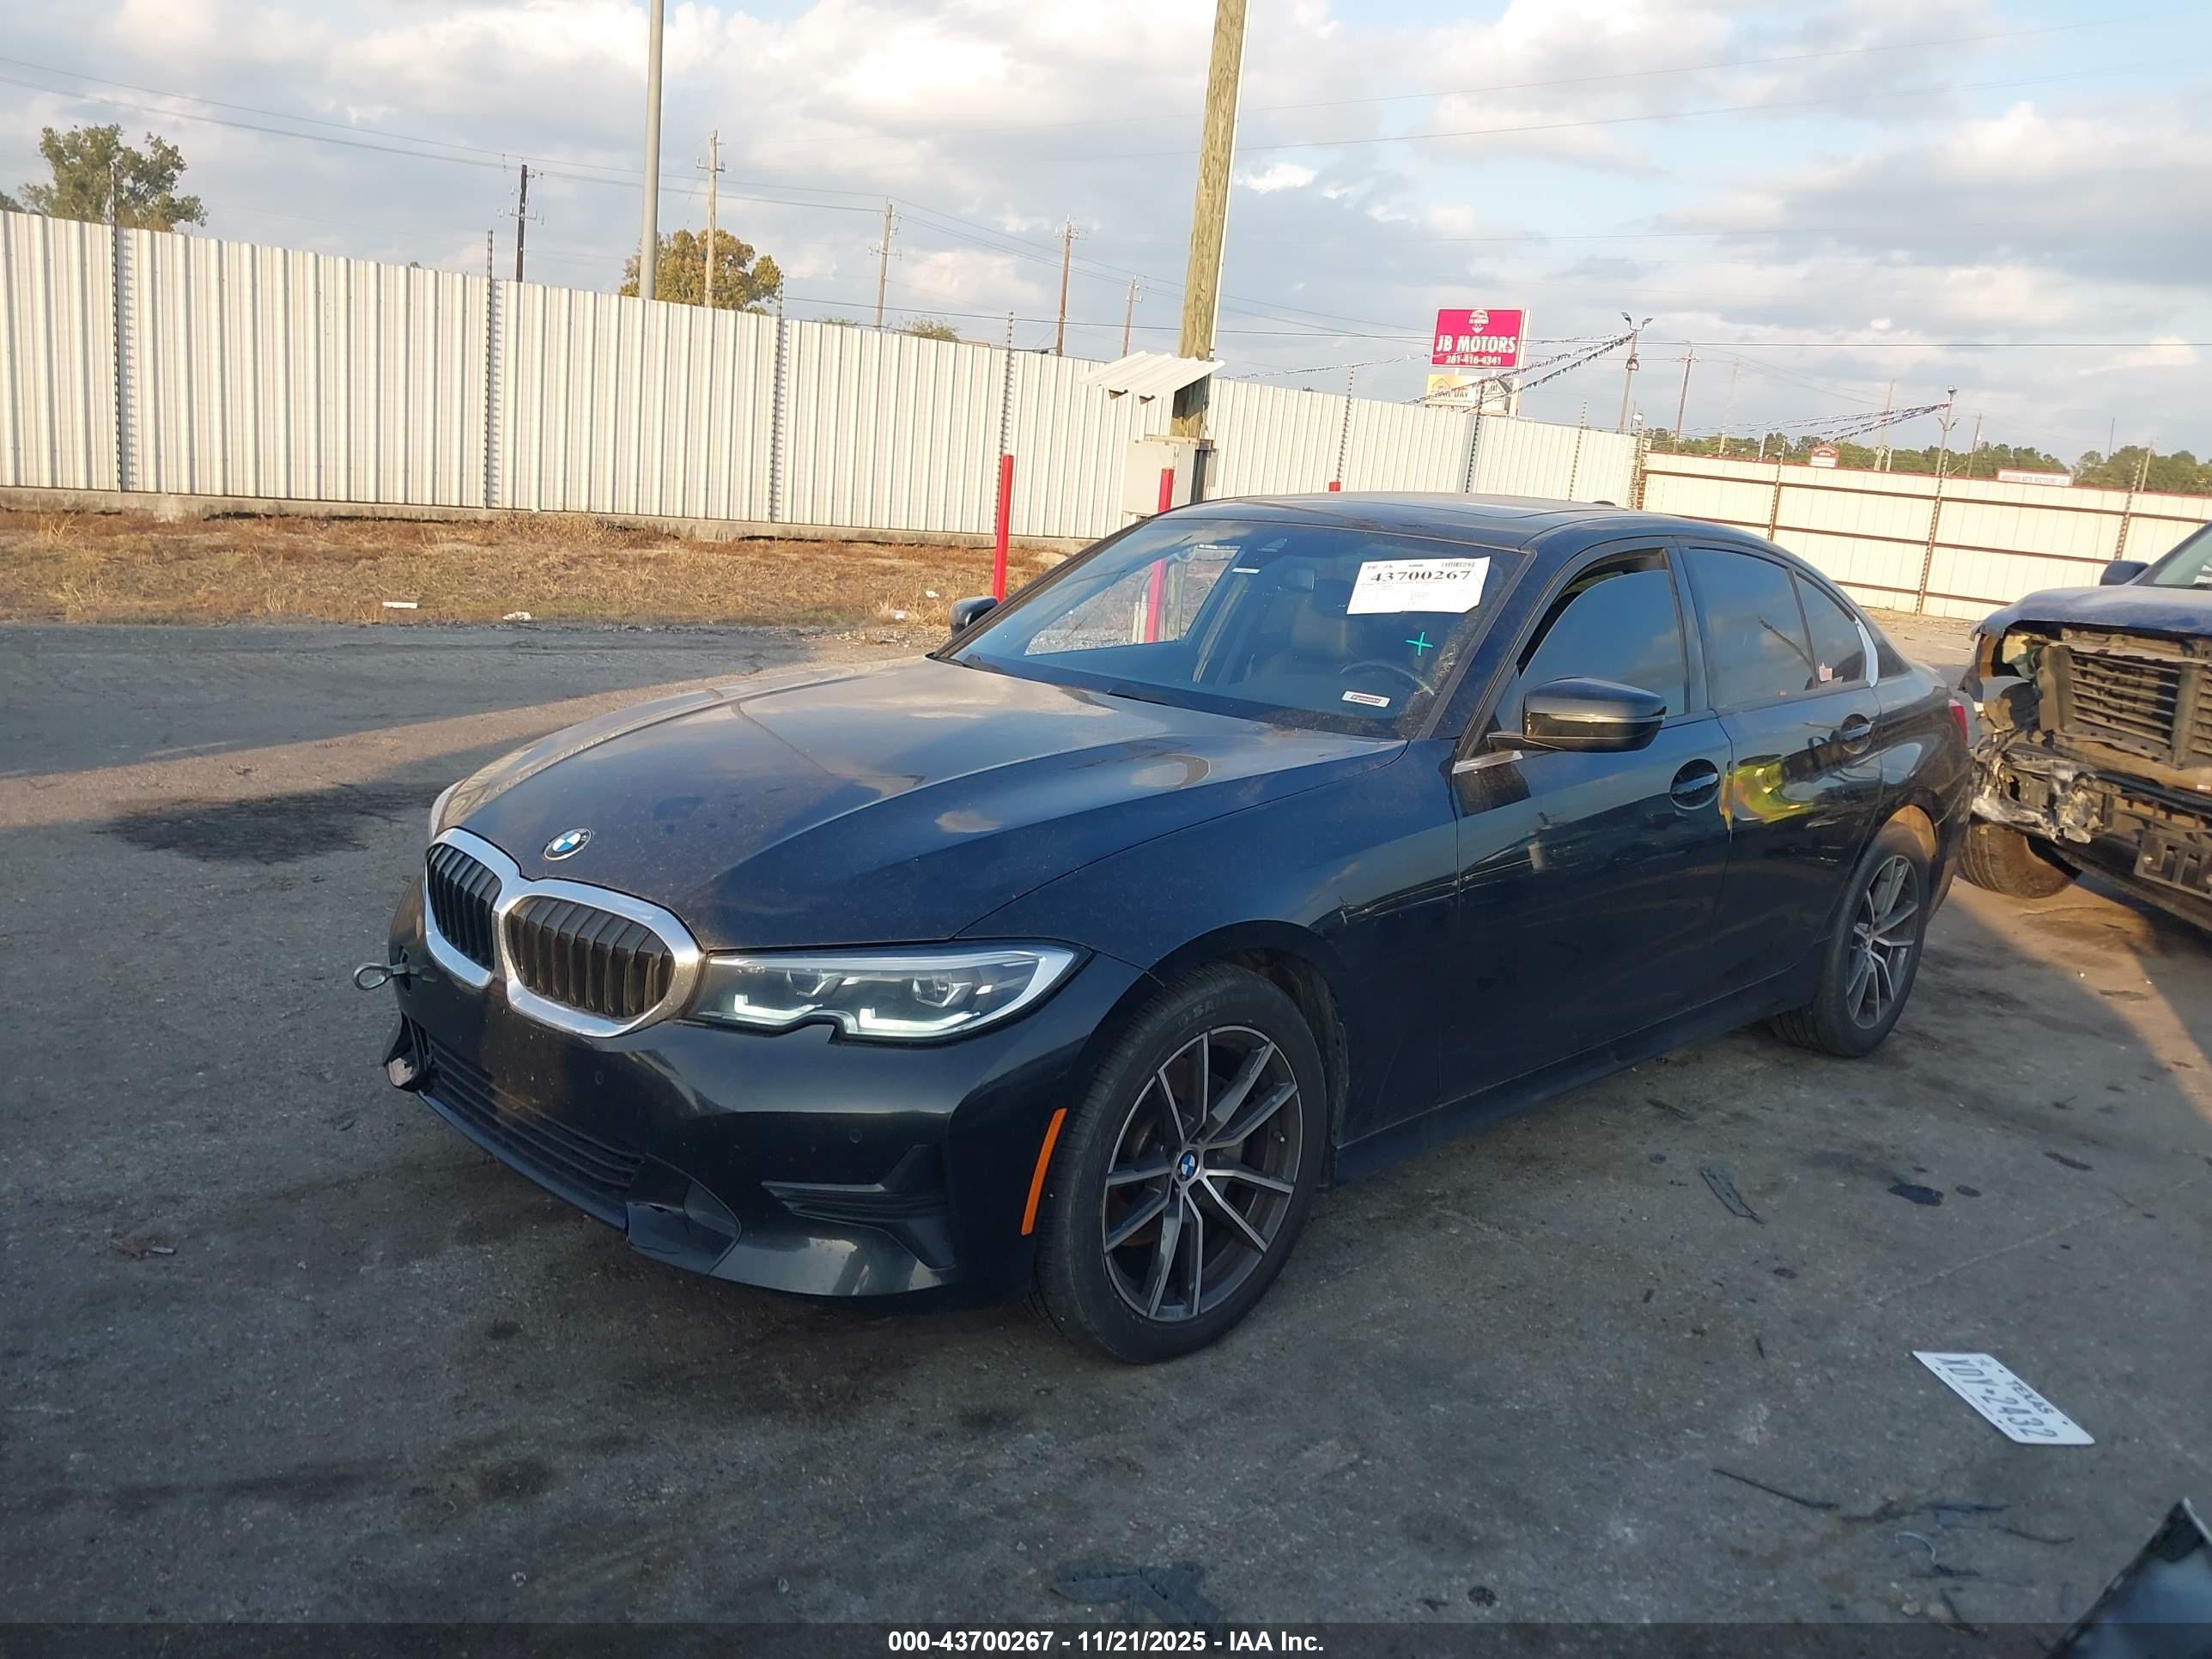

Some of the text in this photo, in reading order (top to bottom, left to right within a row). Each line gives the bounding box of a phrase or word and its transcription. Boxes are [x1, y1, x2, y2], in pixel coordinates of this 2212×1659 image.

[1436, 334, 1517, 354] JB MOTORS
[1444, 355, 1502, 365] 281-416-4341
[1370, 569, 1472, 582] 43700267
[2005, 1380, 2055, 1414] TEXAS
